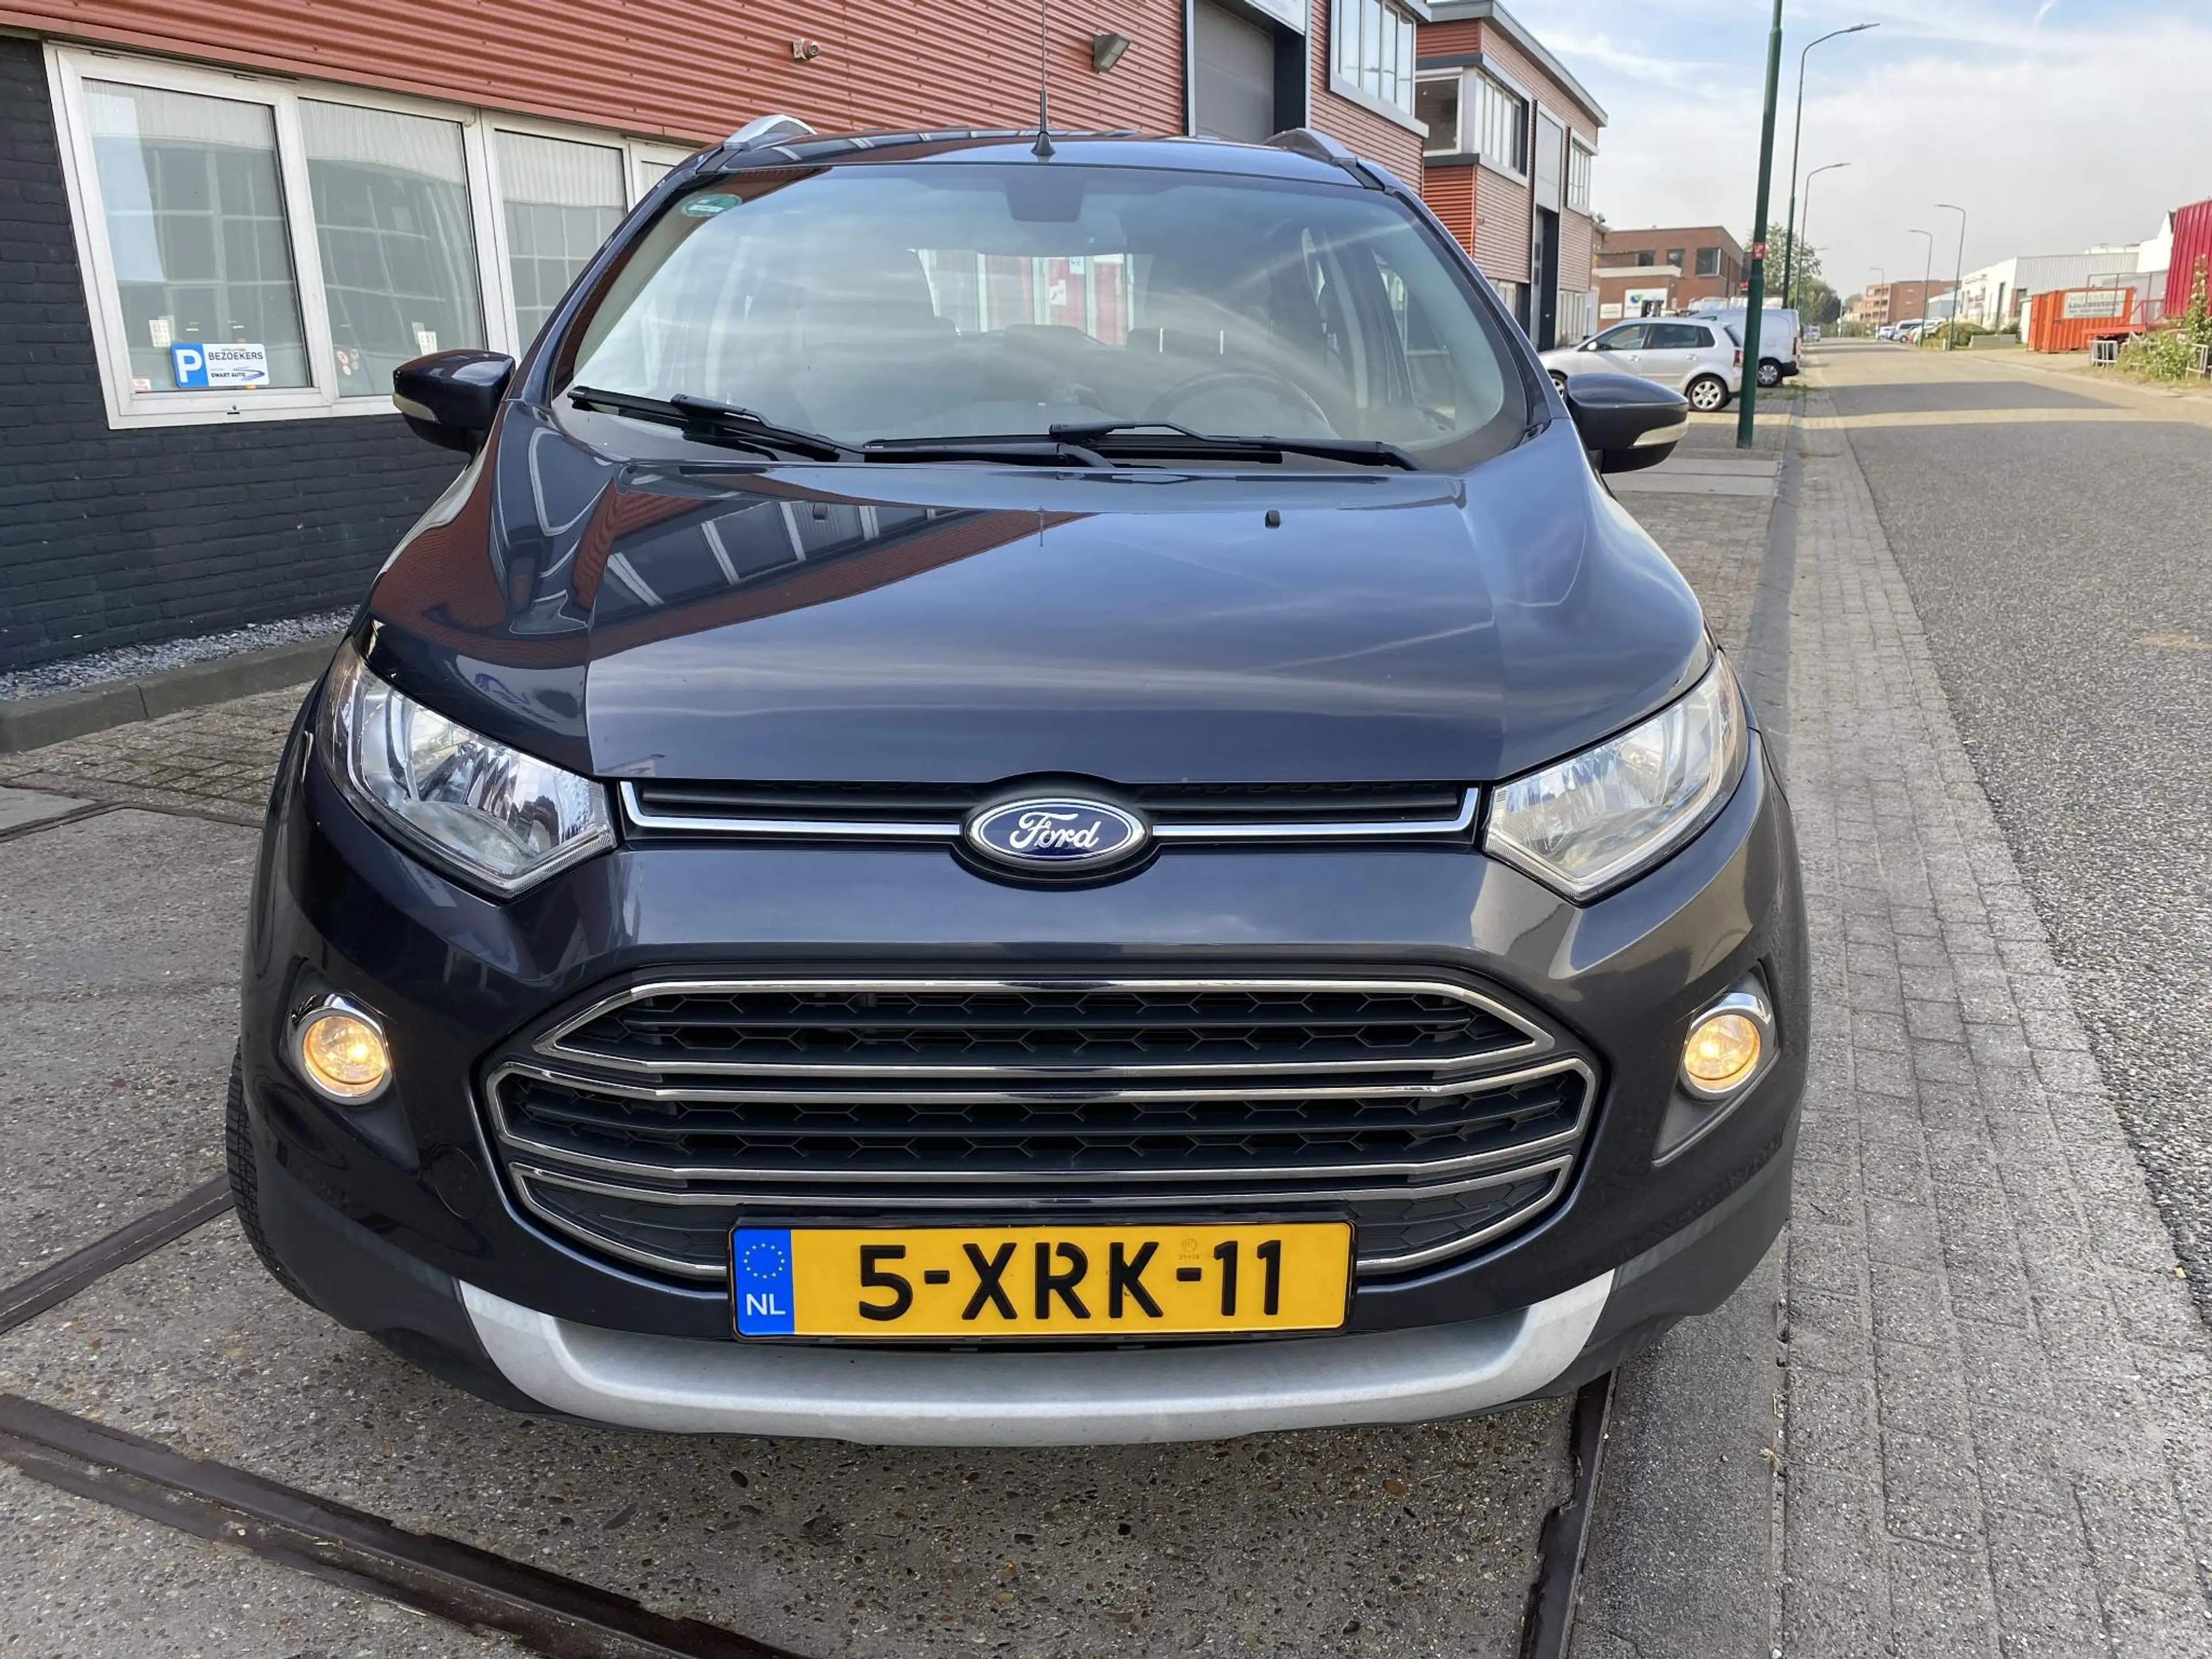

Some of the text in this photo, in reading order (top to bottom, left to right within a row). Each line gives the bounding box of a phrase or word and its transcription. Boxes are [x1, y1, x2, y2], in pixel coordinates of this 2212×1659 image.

[175, 349, 202, 382] P
[208, 352, 263, 361] BEZOEKERS
[1009, 812, 1101, 849] Ford
[859, 1240, 1281, 1321] 5-XRK-11
[746, 1293, 786, 1316] NL
